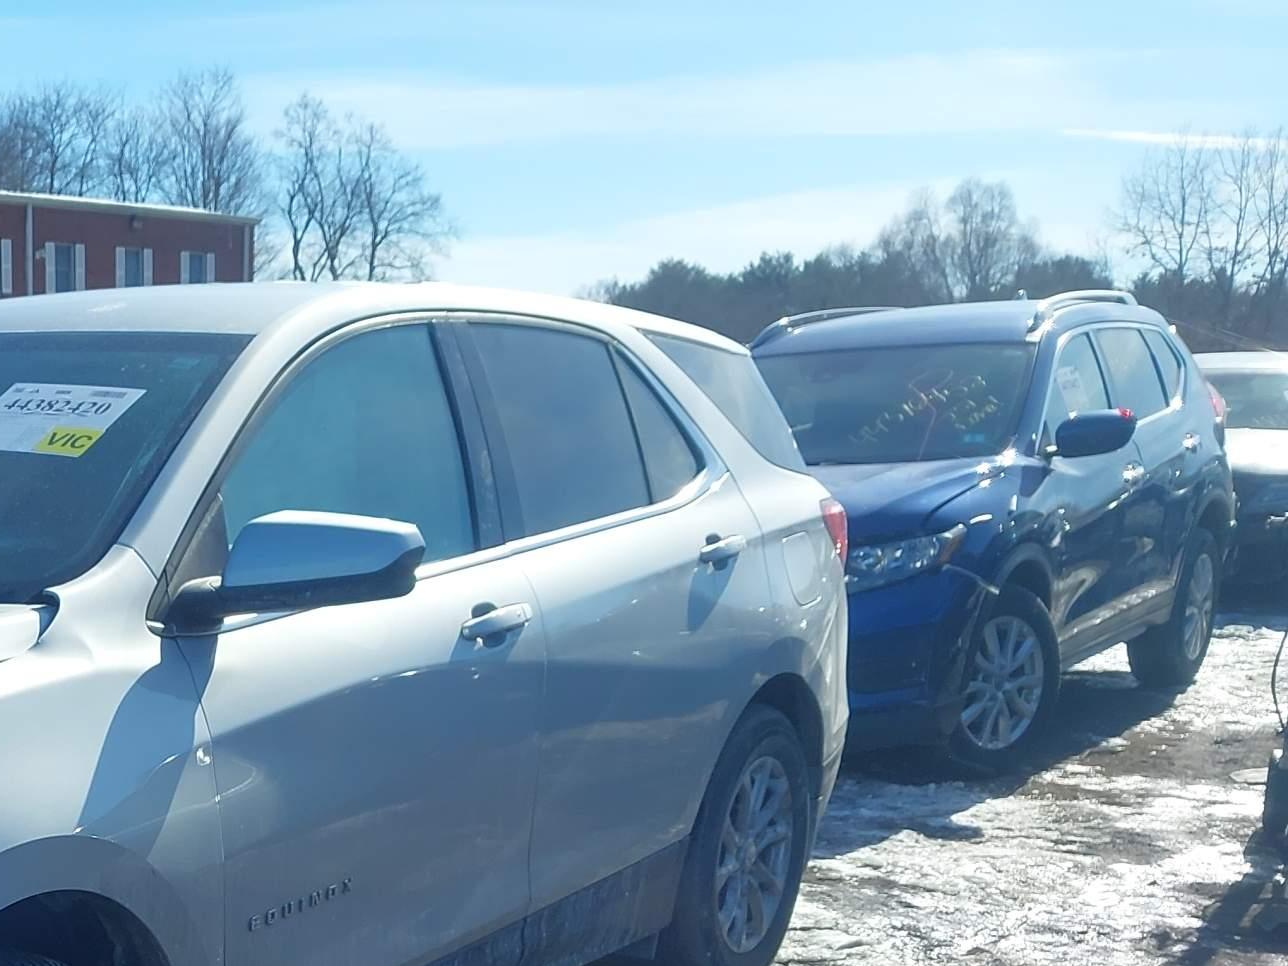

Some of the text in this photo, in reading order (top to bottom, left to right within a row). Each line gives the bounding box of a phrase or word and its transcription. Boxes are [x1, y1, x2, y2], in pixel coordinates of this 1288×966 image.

[4, 398, 112, 415] 44382420
[47, 432, 93, 448] VIC
[247, 877, 353, 932] EQUINOX
